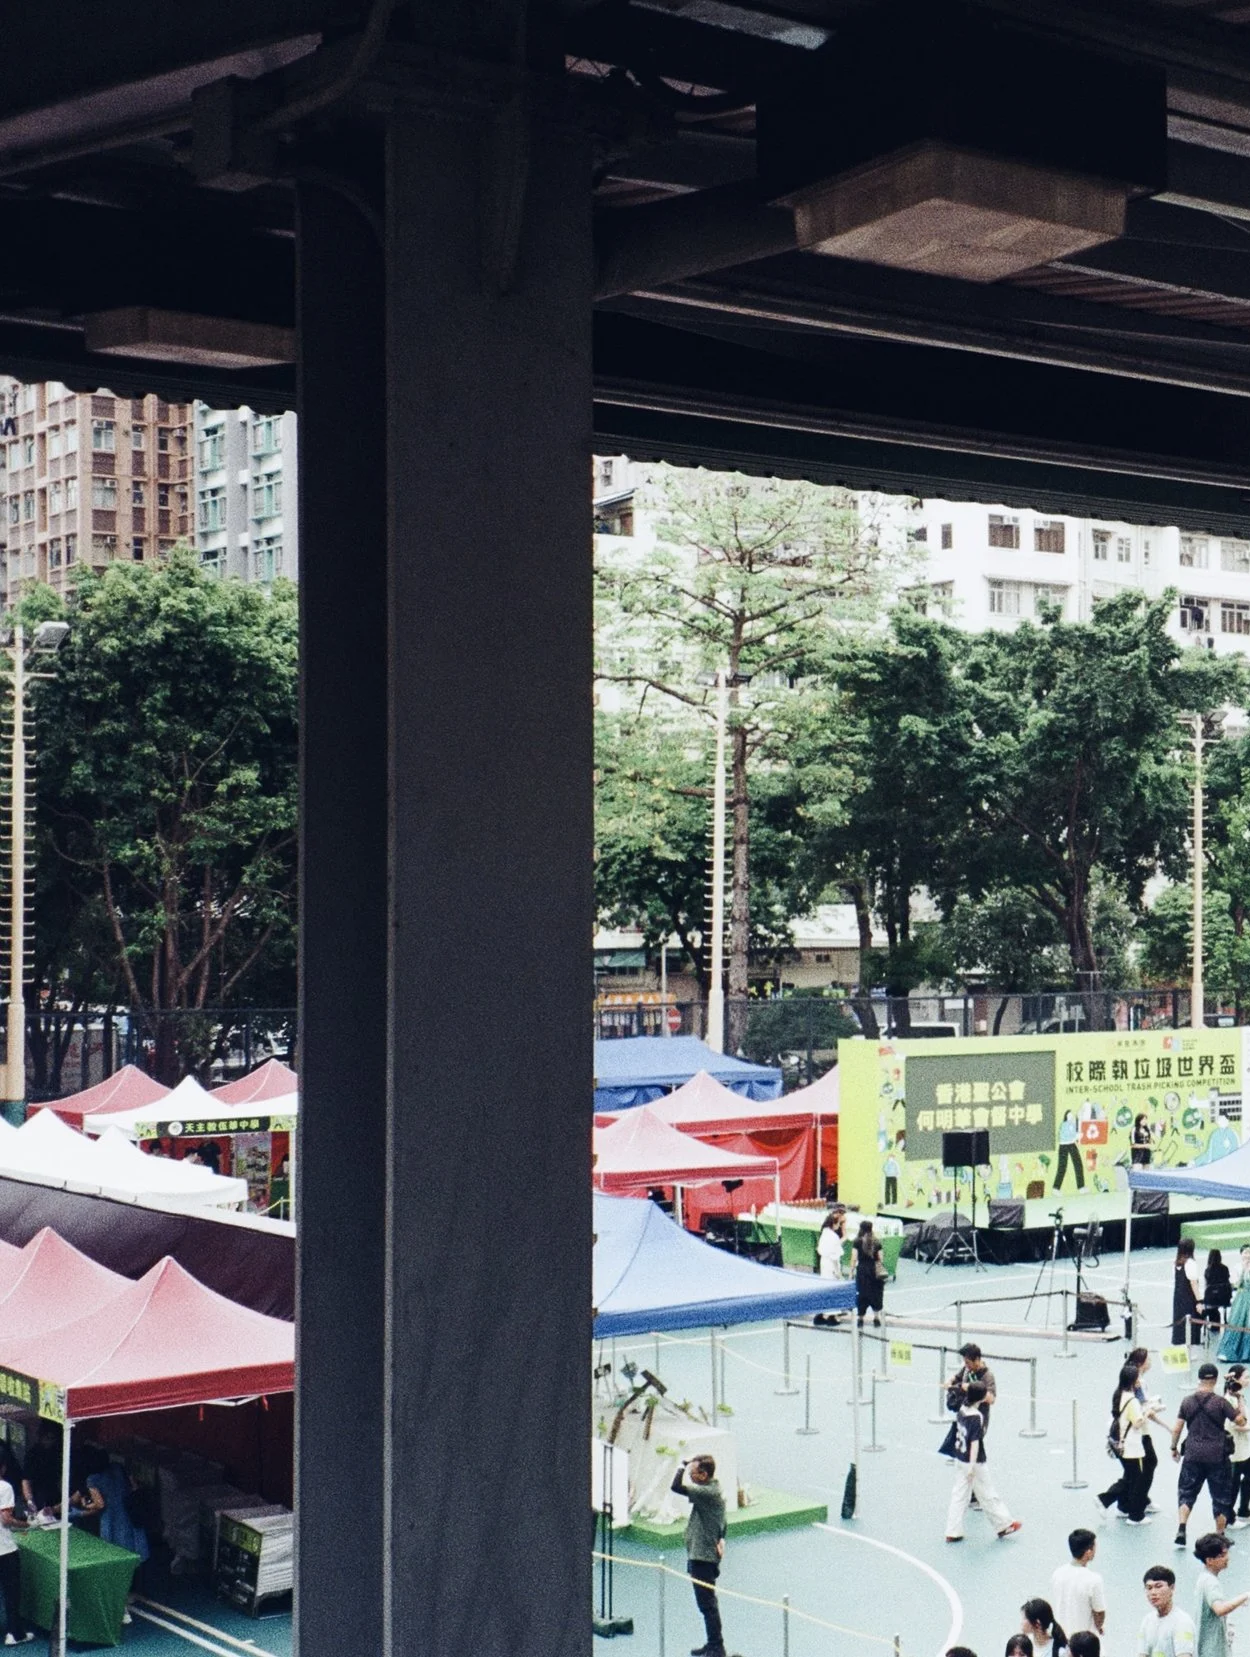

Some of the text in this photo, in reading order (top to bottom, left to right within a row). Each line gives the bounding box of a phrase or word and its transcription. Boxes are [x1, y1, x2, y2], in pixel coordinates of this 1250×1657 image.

[1065, 1053, 1236, 1083] 校際執垃圾世界盃
[1065, 1077, 1236, 1095] INTER-SCHOOL TRASH PICKING COMPETITION
